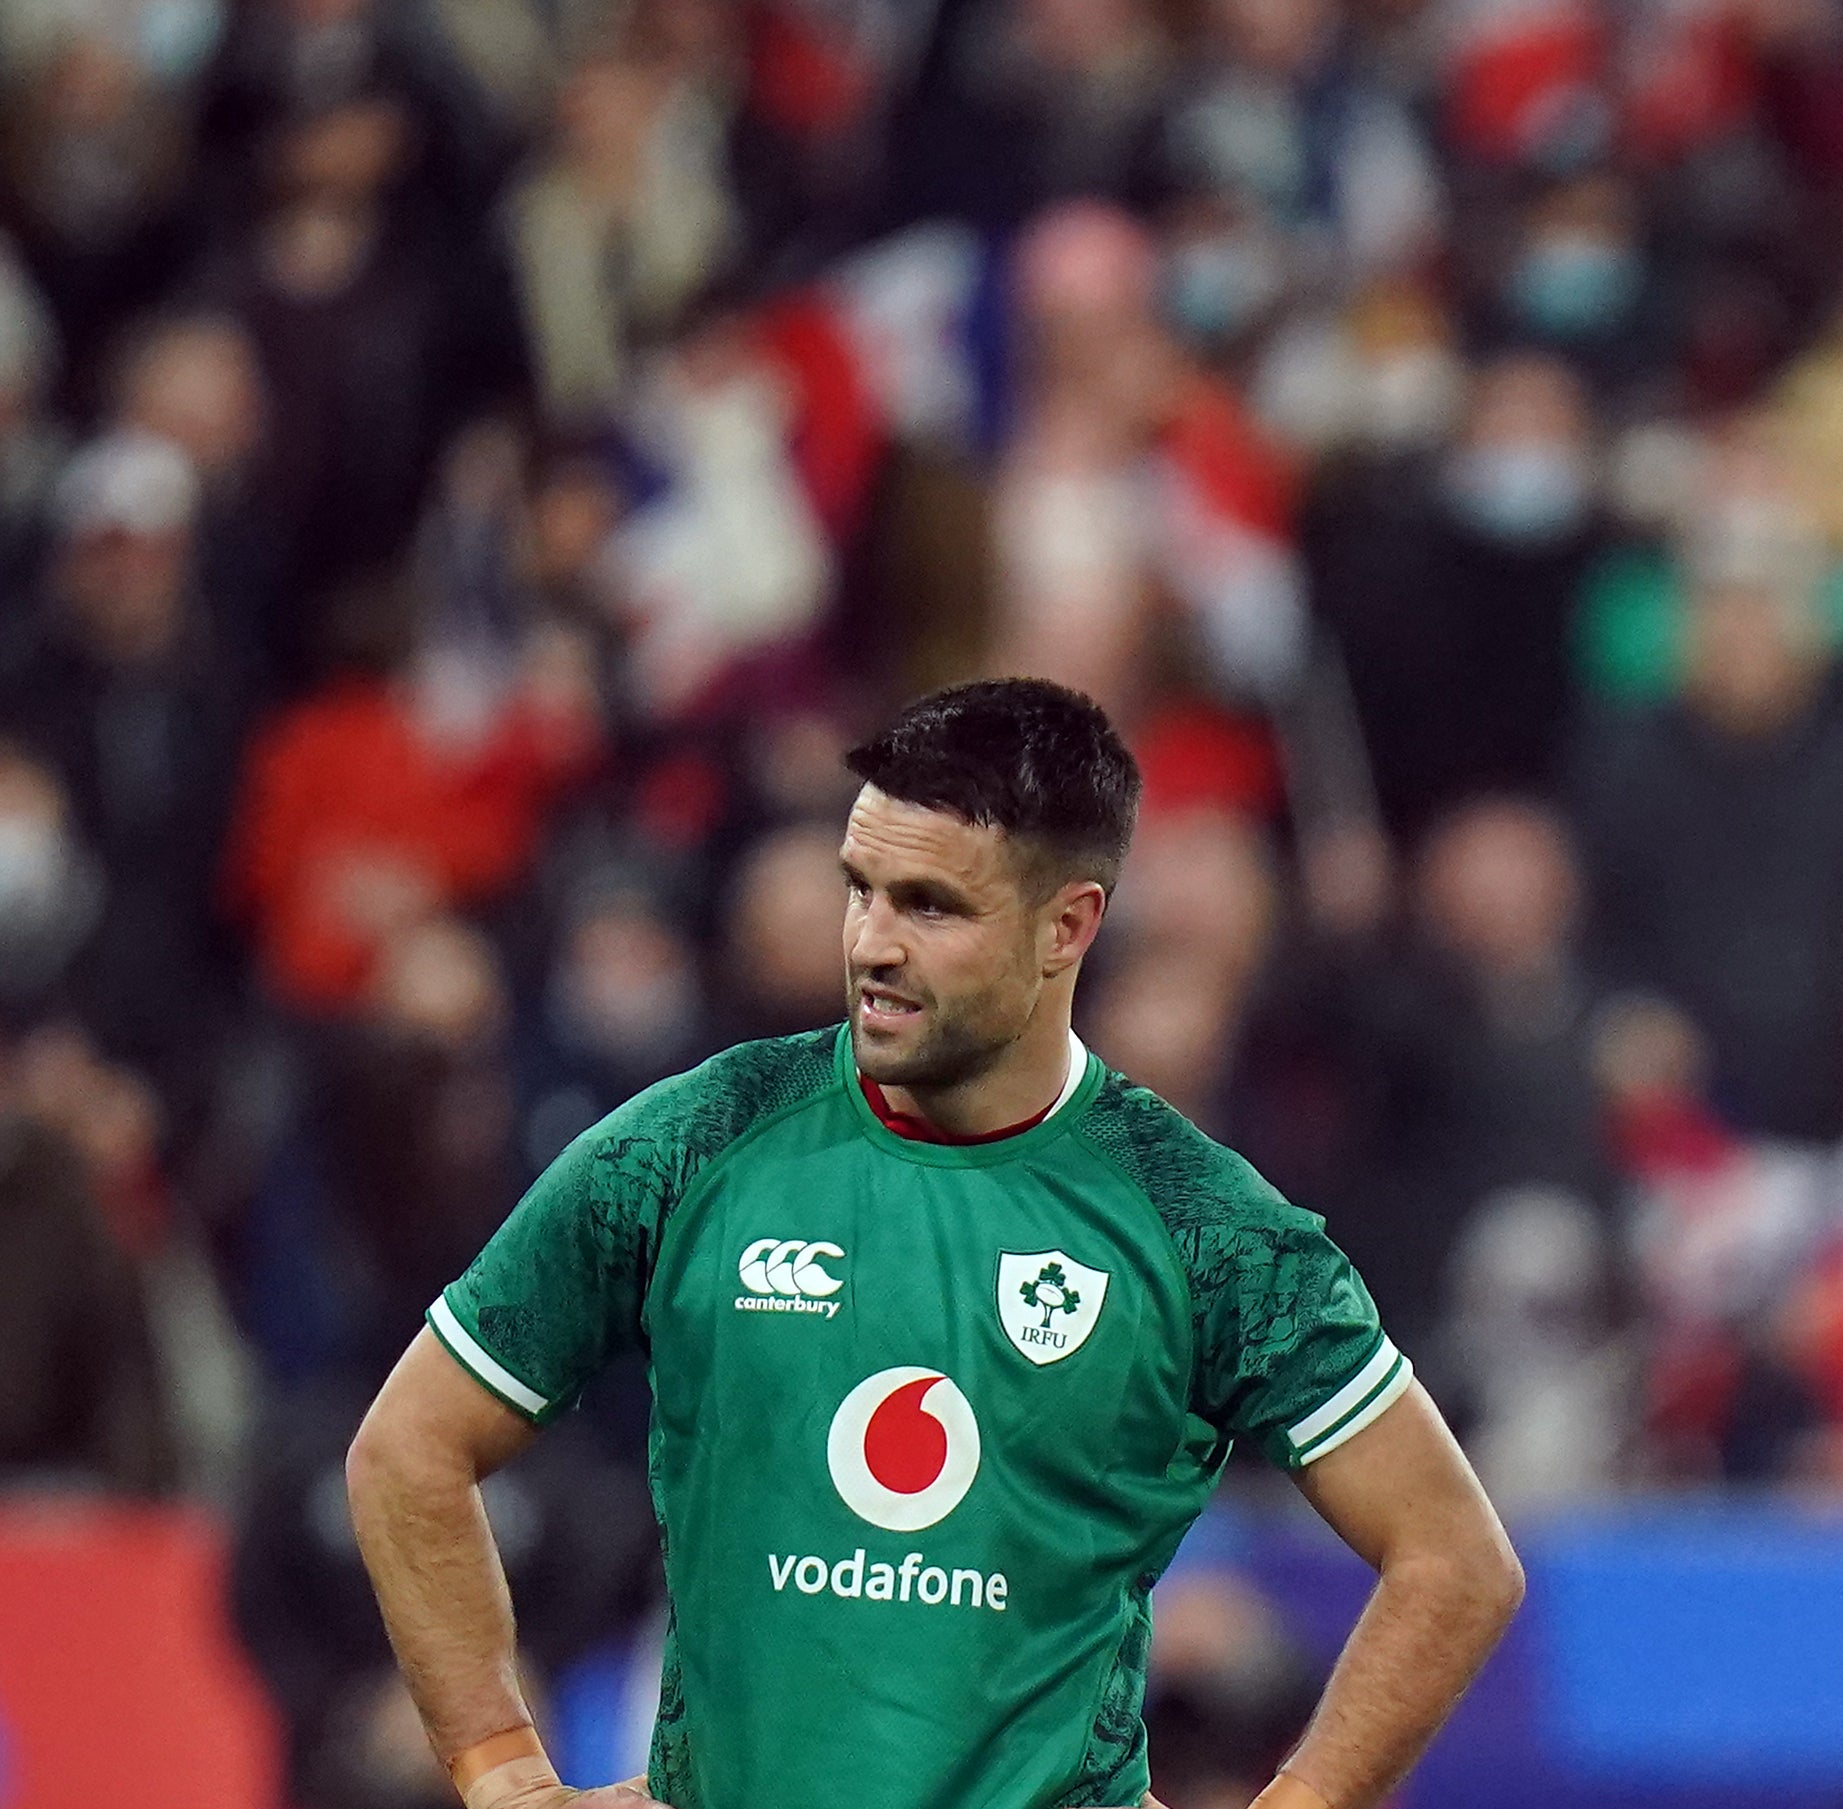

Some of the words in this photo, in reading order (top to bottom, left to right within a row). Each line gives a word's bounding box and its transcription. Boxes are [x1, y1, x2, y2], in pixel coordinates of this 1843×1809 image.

[735, 1294, 841, 1318] canterbury
[1021, 1326, 1067, 1349] IRFU
[768, 1549, 1008, 1611] vodafone
